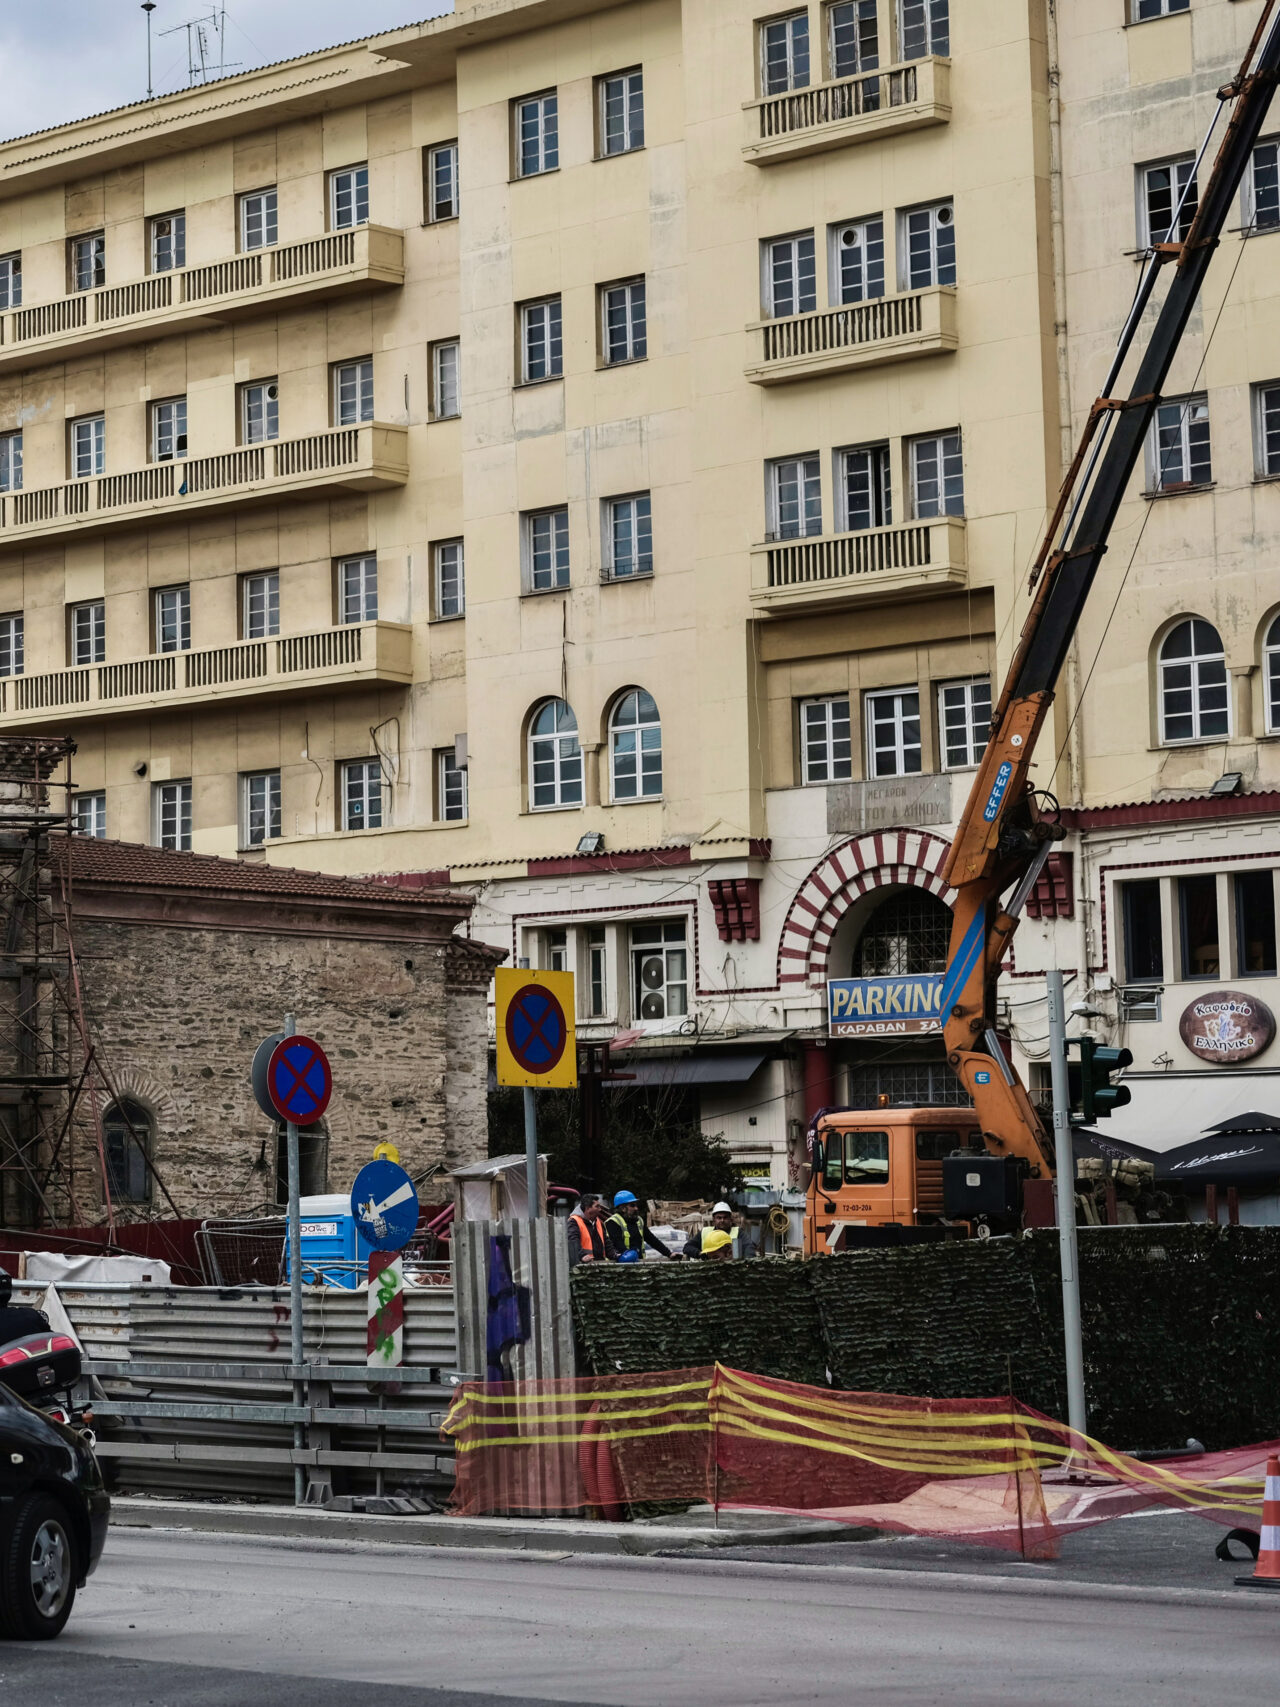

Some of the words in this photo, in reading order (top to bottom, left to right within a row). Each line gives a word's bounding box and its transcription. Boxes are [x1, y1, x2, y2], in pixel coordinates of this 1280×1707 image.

[985, 765, 1011, 819] EFFER
[1195, 1001, 1252, 1016] Καφωδείο
[837, 1022, 906, 1035] ΚΑΡΑΒΑΝ
[919, 1020, 943, 1031] ΣΑ
[1195, 1035, 1254, 1052] Ελληνικό
